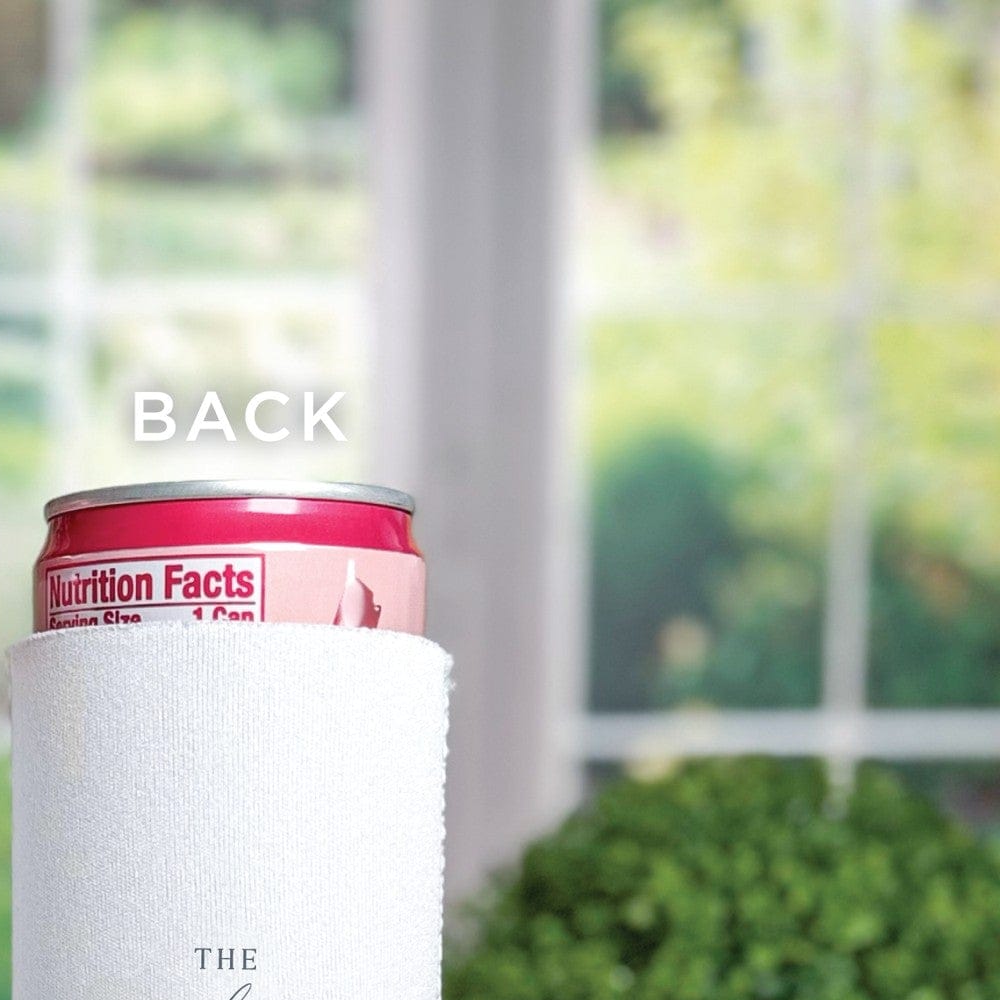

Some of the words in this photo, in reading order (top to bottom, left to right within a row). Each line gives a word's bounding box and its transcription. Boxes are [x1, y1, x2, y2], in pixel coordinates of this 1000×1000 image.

[50, 568, 153, 608] Nutrition
[164, 564, 254, 599] Facts
[193, 947, 258, 971] THE
